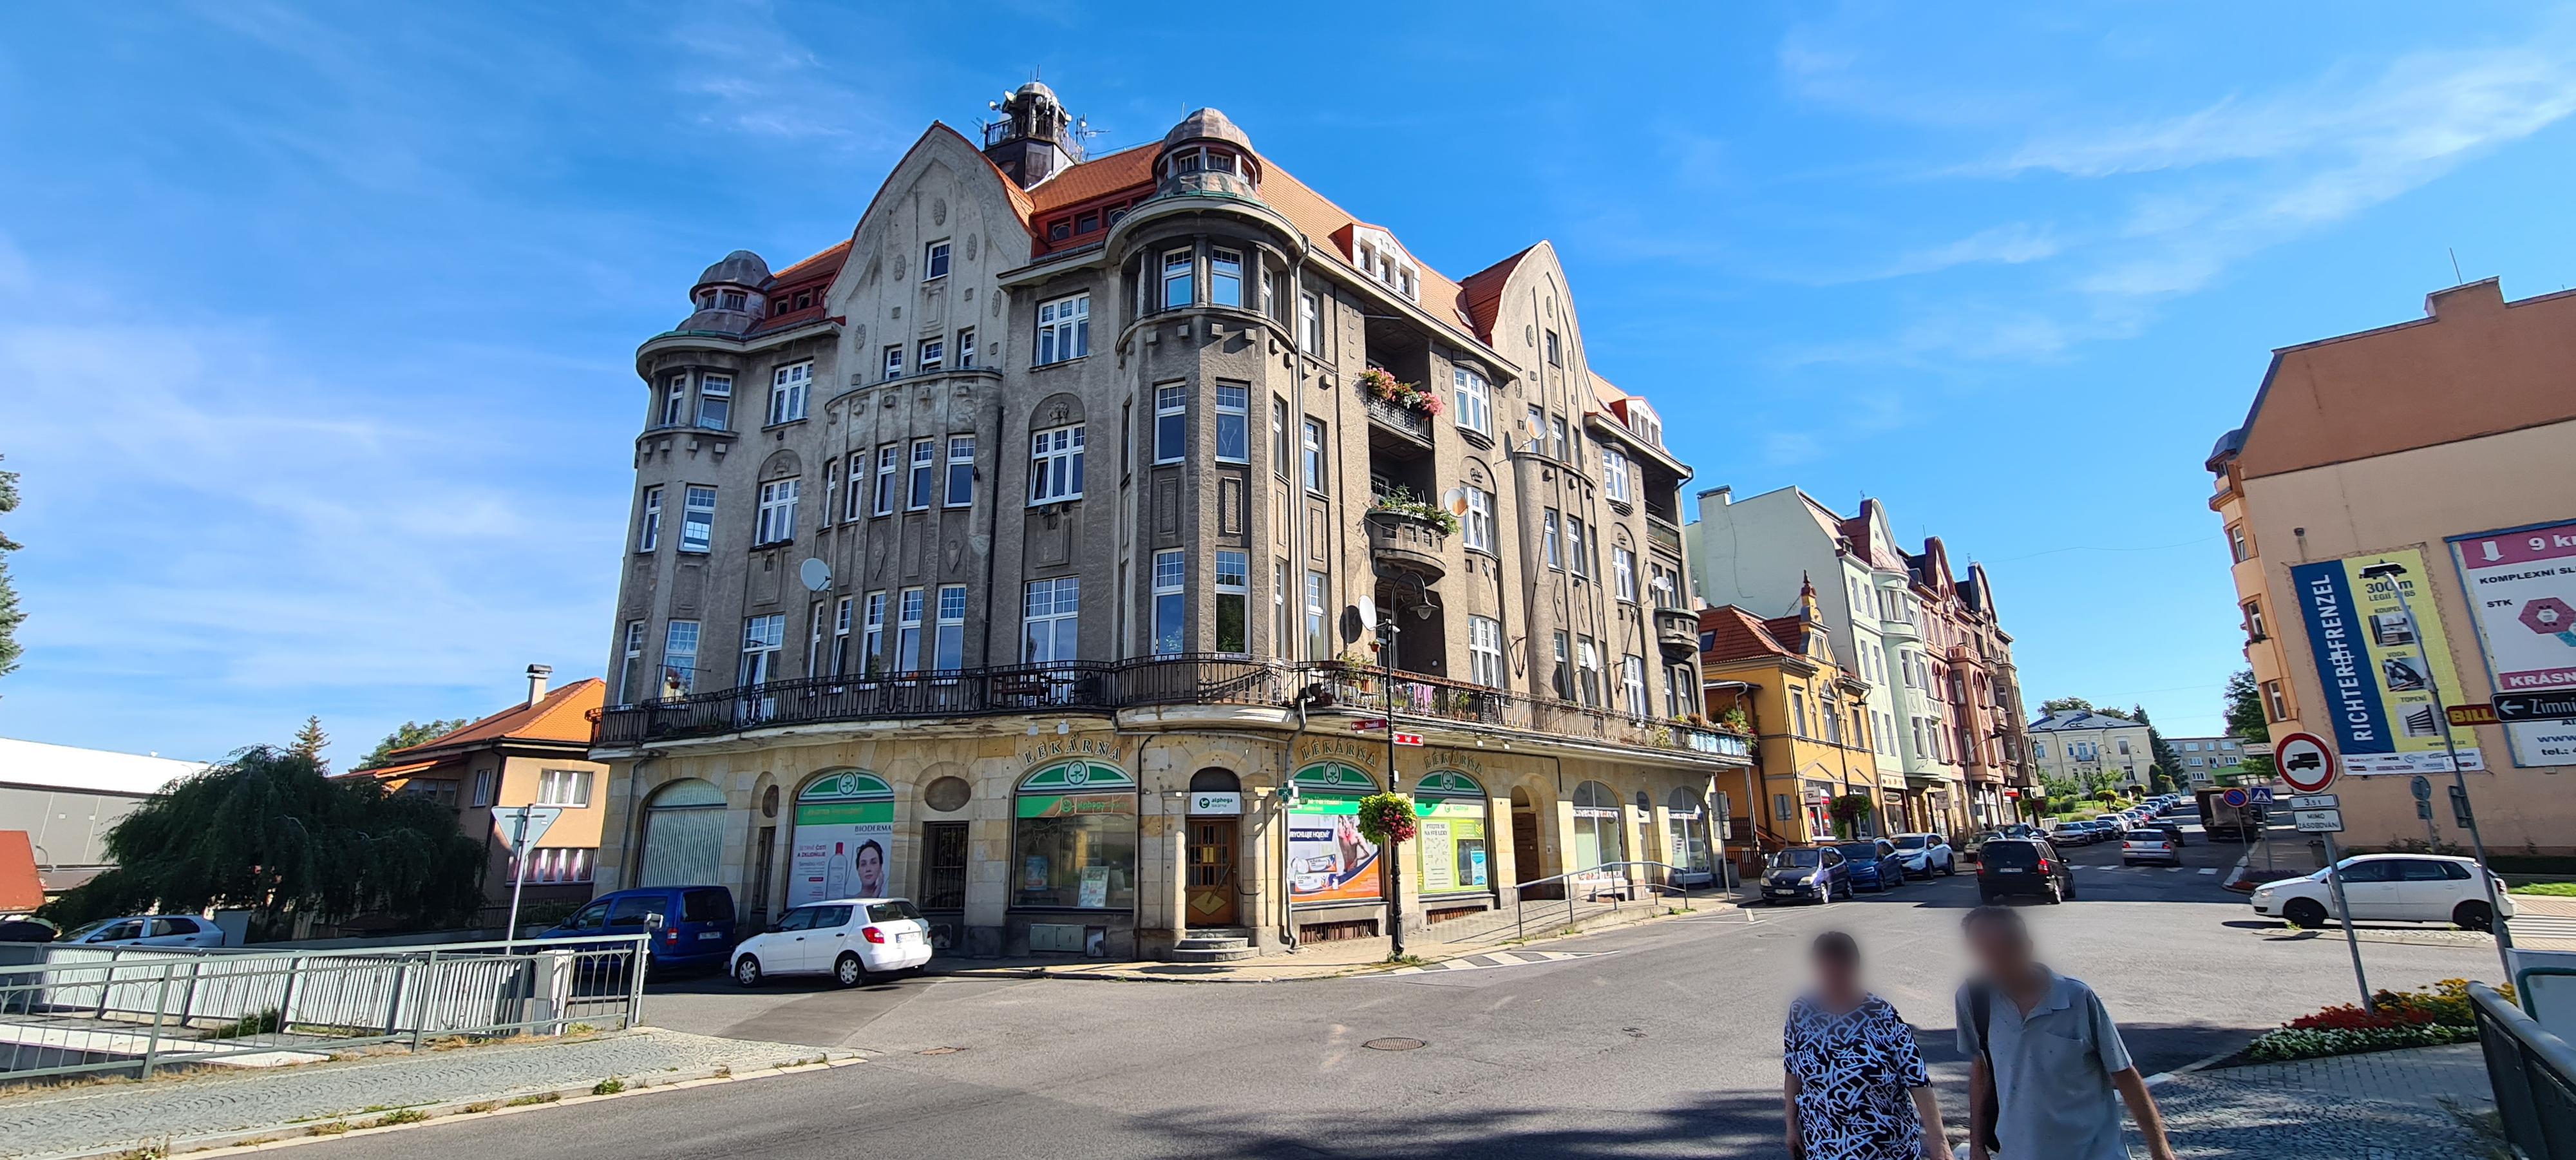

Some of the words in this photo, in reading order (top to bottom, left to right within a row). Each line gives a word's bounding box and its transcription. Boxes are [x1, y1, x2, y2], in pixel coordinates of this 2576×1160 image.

[2528, 537, 2546, 551] 9
[2479, 568, 2555, 585] KOMPLEXNÍ
[2559, 566, 2576, 575] SL
[2365, 581, 2394, 594] 300
[2398, 580, 2413, 589] m
[2374, 605, 2411, 614] KOUPELY
[2486, 599, 2513, 608] STK
[2528, 697, 2576, 714] Zimní
[2449, 708, 2497, 723] BILL
[1023, 734, 1121, 765] LÉKÁRNA
[1301, 739, 1376, 767] LÉKÁRNA
[1425, 748, 1483, 775] LÉKÁRNA
